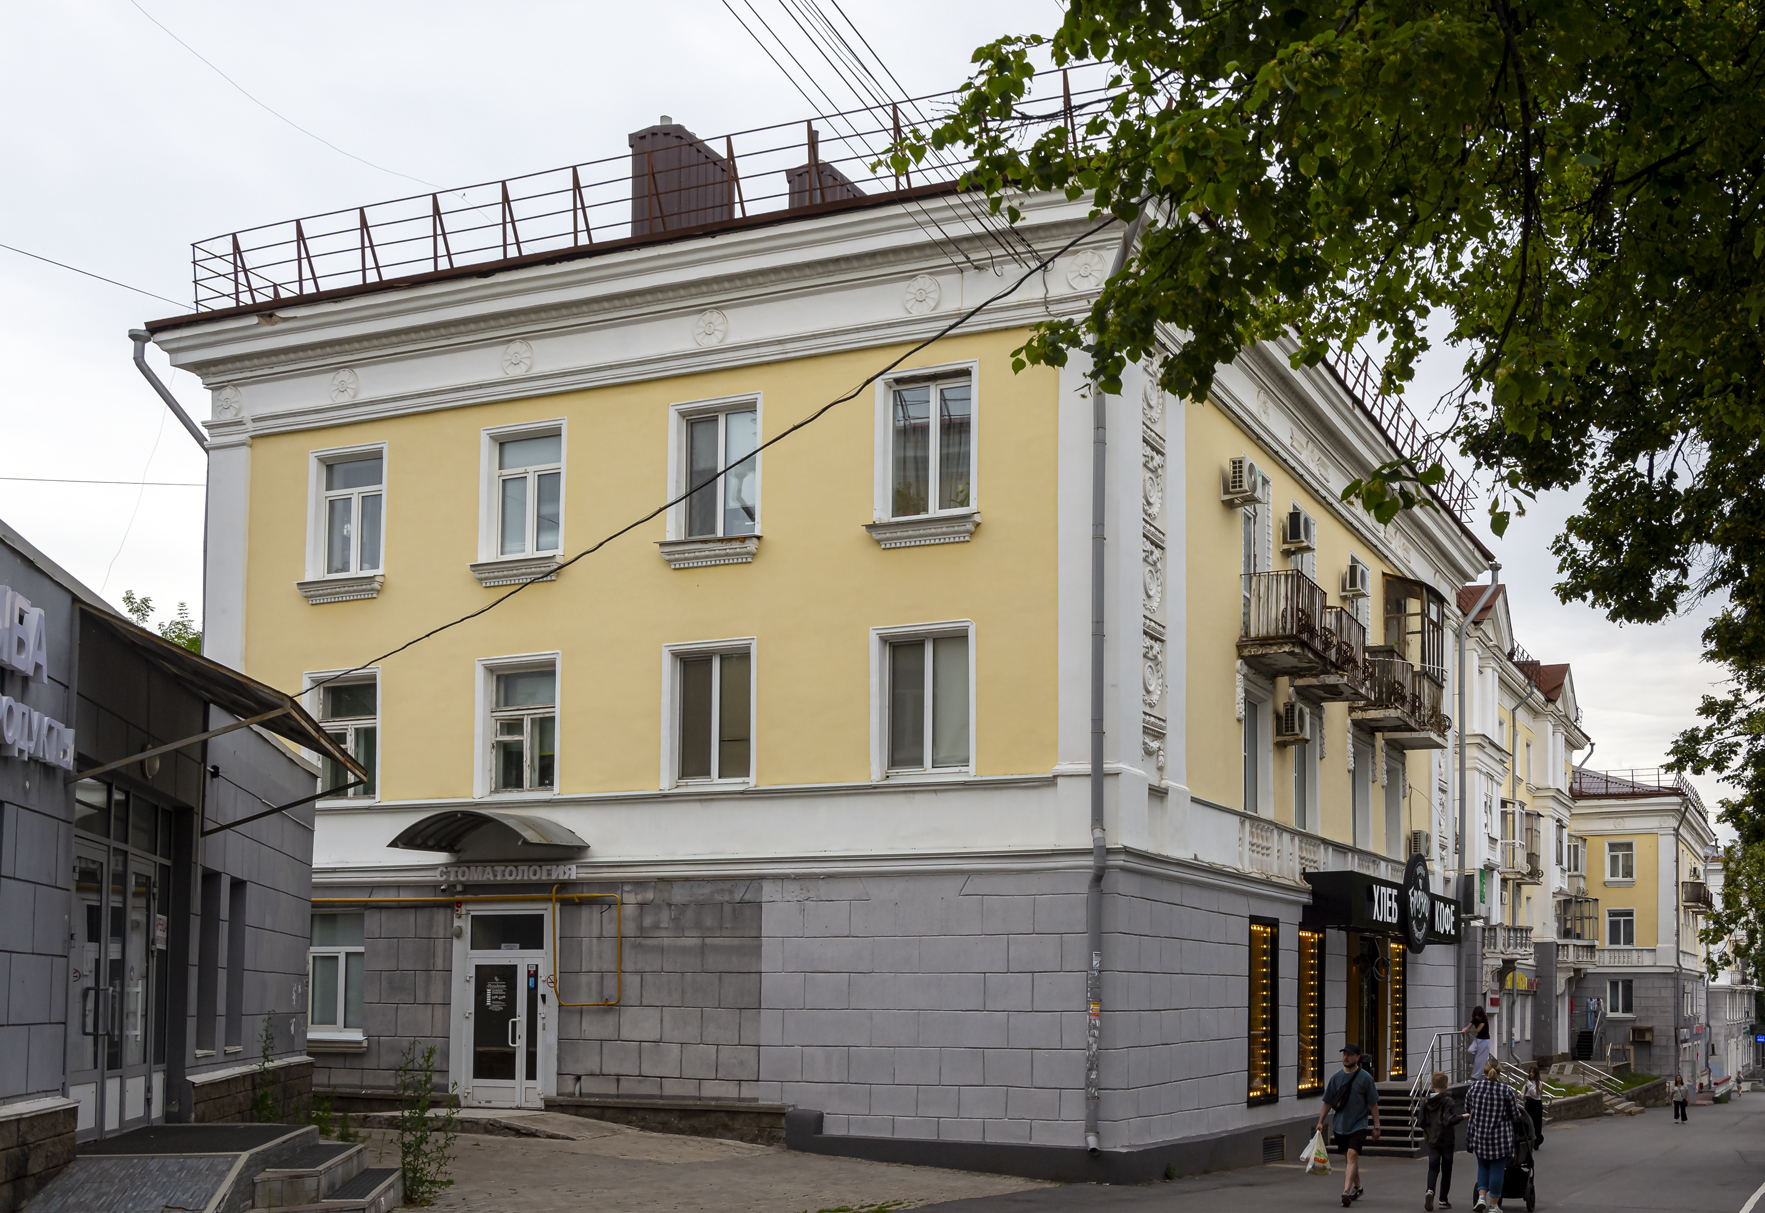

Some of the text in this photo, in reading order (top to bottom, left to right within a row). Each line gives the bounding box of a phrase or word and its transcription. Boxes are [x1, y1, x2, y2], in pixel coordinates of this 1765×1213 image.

[0, 584, 48, 685] БА
[0, 692, 75, 770] ОДУКТЫ
[436, 864, 577, 881] СТОМАТОЛОГИЯ
[1372, 884, 1398, 924] ХЛЕБ
[1434, 900, 1456, 935] КОФЕ
